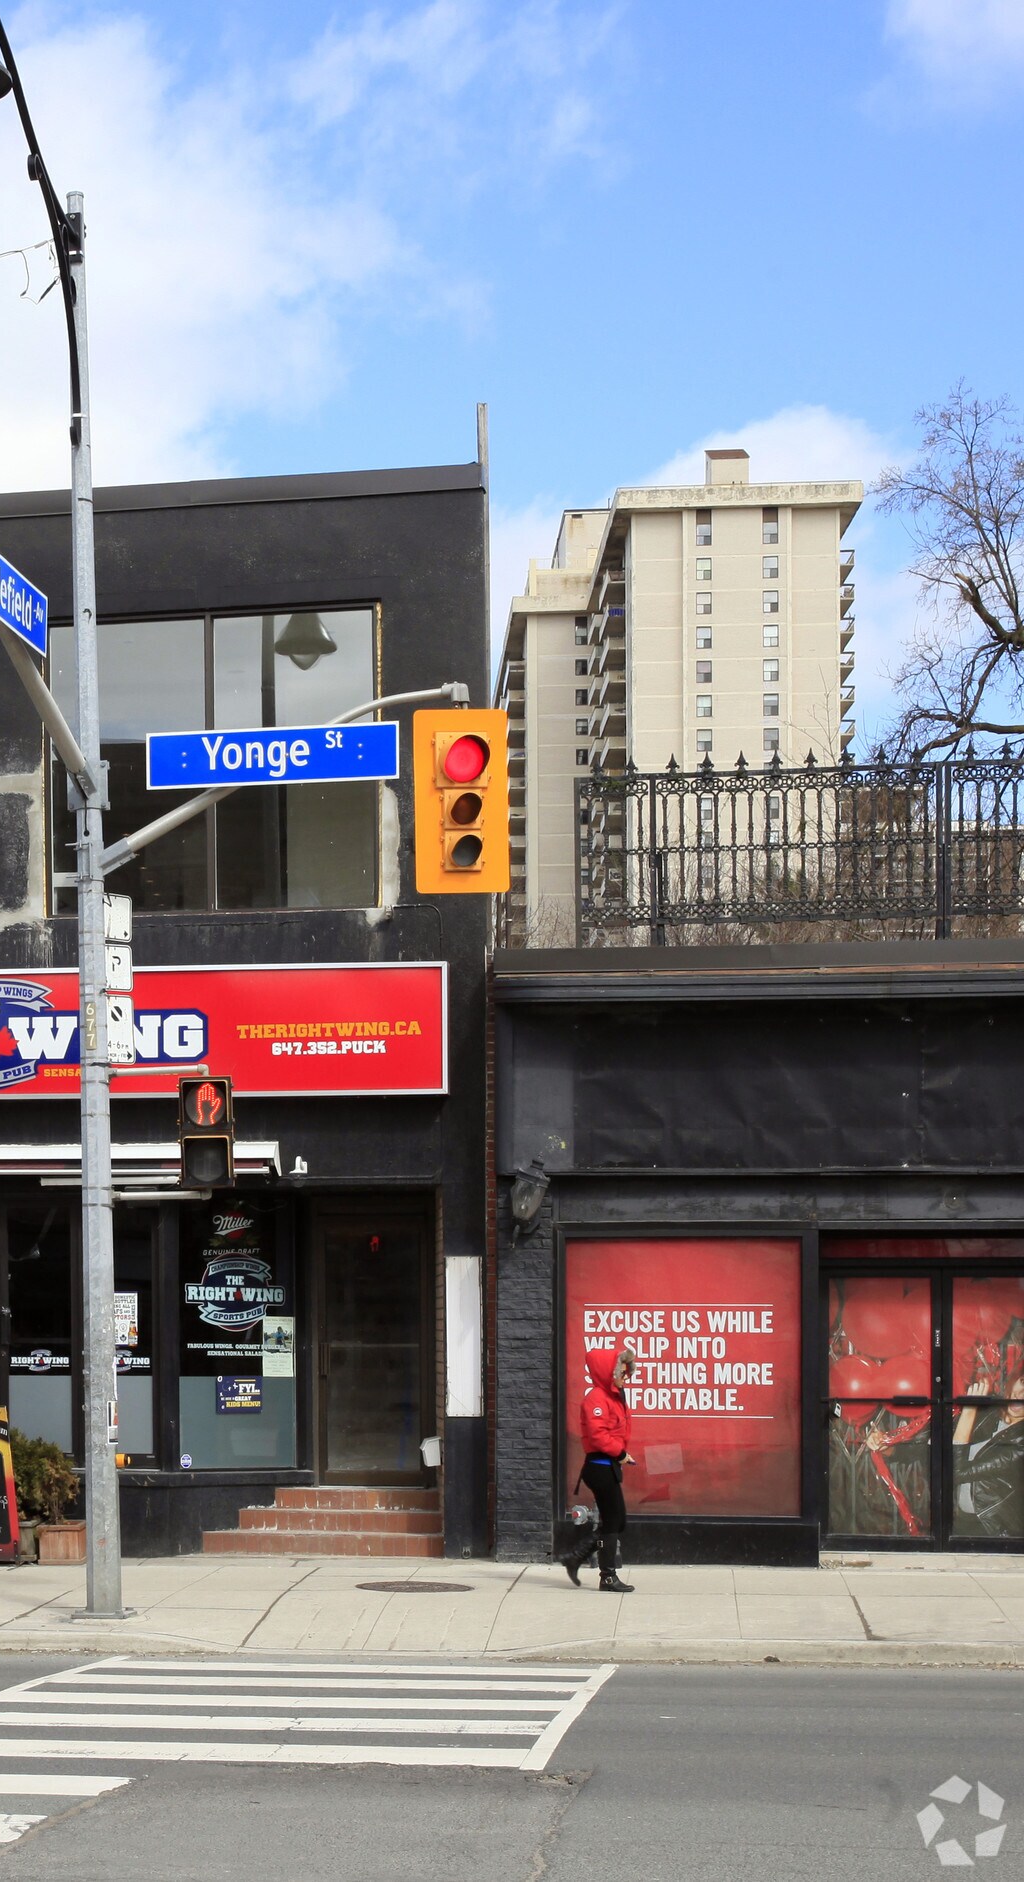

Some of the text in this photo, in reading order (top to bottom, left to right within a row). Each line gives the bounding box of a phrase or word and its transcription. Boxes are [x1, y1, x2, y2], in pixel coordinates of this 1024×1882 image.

[201, 730, 343, 777] Yonge St
[4, 986, 33, 998] WINGS
[86, 1003, 95, 1047] 677
[236, 1020, 422, 1039] THERIGHTWING.CA
[8, 1014, 204, 1060] WNG
[271, 1040, 387, 1056] 647.352.PUCK
[2, 1064, 32, 1080] PUB
[213, 1214, 254, 1232] Miller
[225, 1275, 245, 1286] THE
[187, 1286, 284, 1302] RIGHT WING
[213, 1308, 263, 1320] SPORTS PUB
[584, 1310, 773, 1333] EXCUSE US WHILE
[584, 1336, 726, 1359] WE SLIP INTO
[11, 1356, 69, 1365] RIGHT WING
[123, 1357, 150, 1365] WING
[584, 1362, 773, 1385] ETHING MORE
[584, 1387, 744, 1411] FORTABLE.
